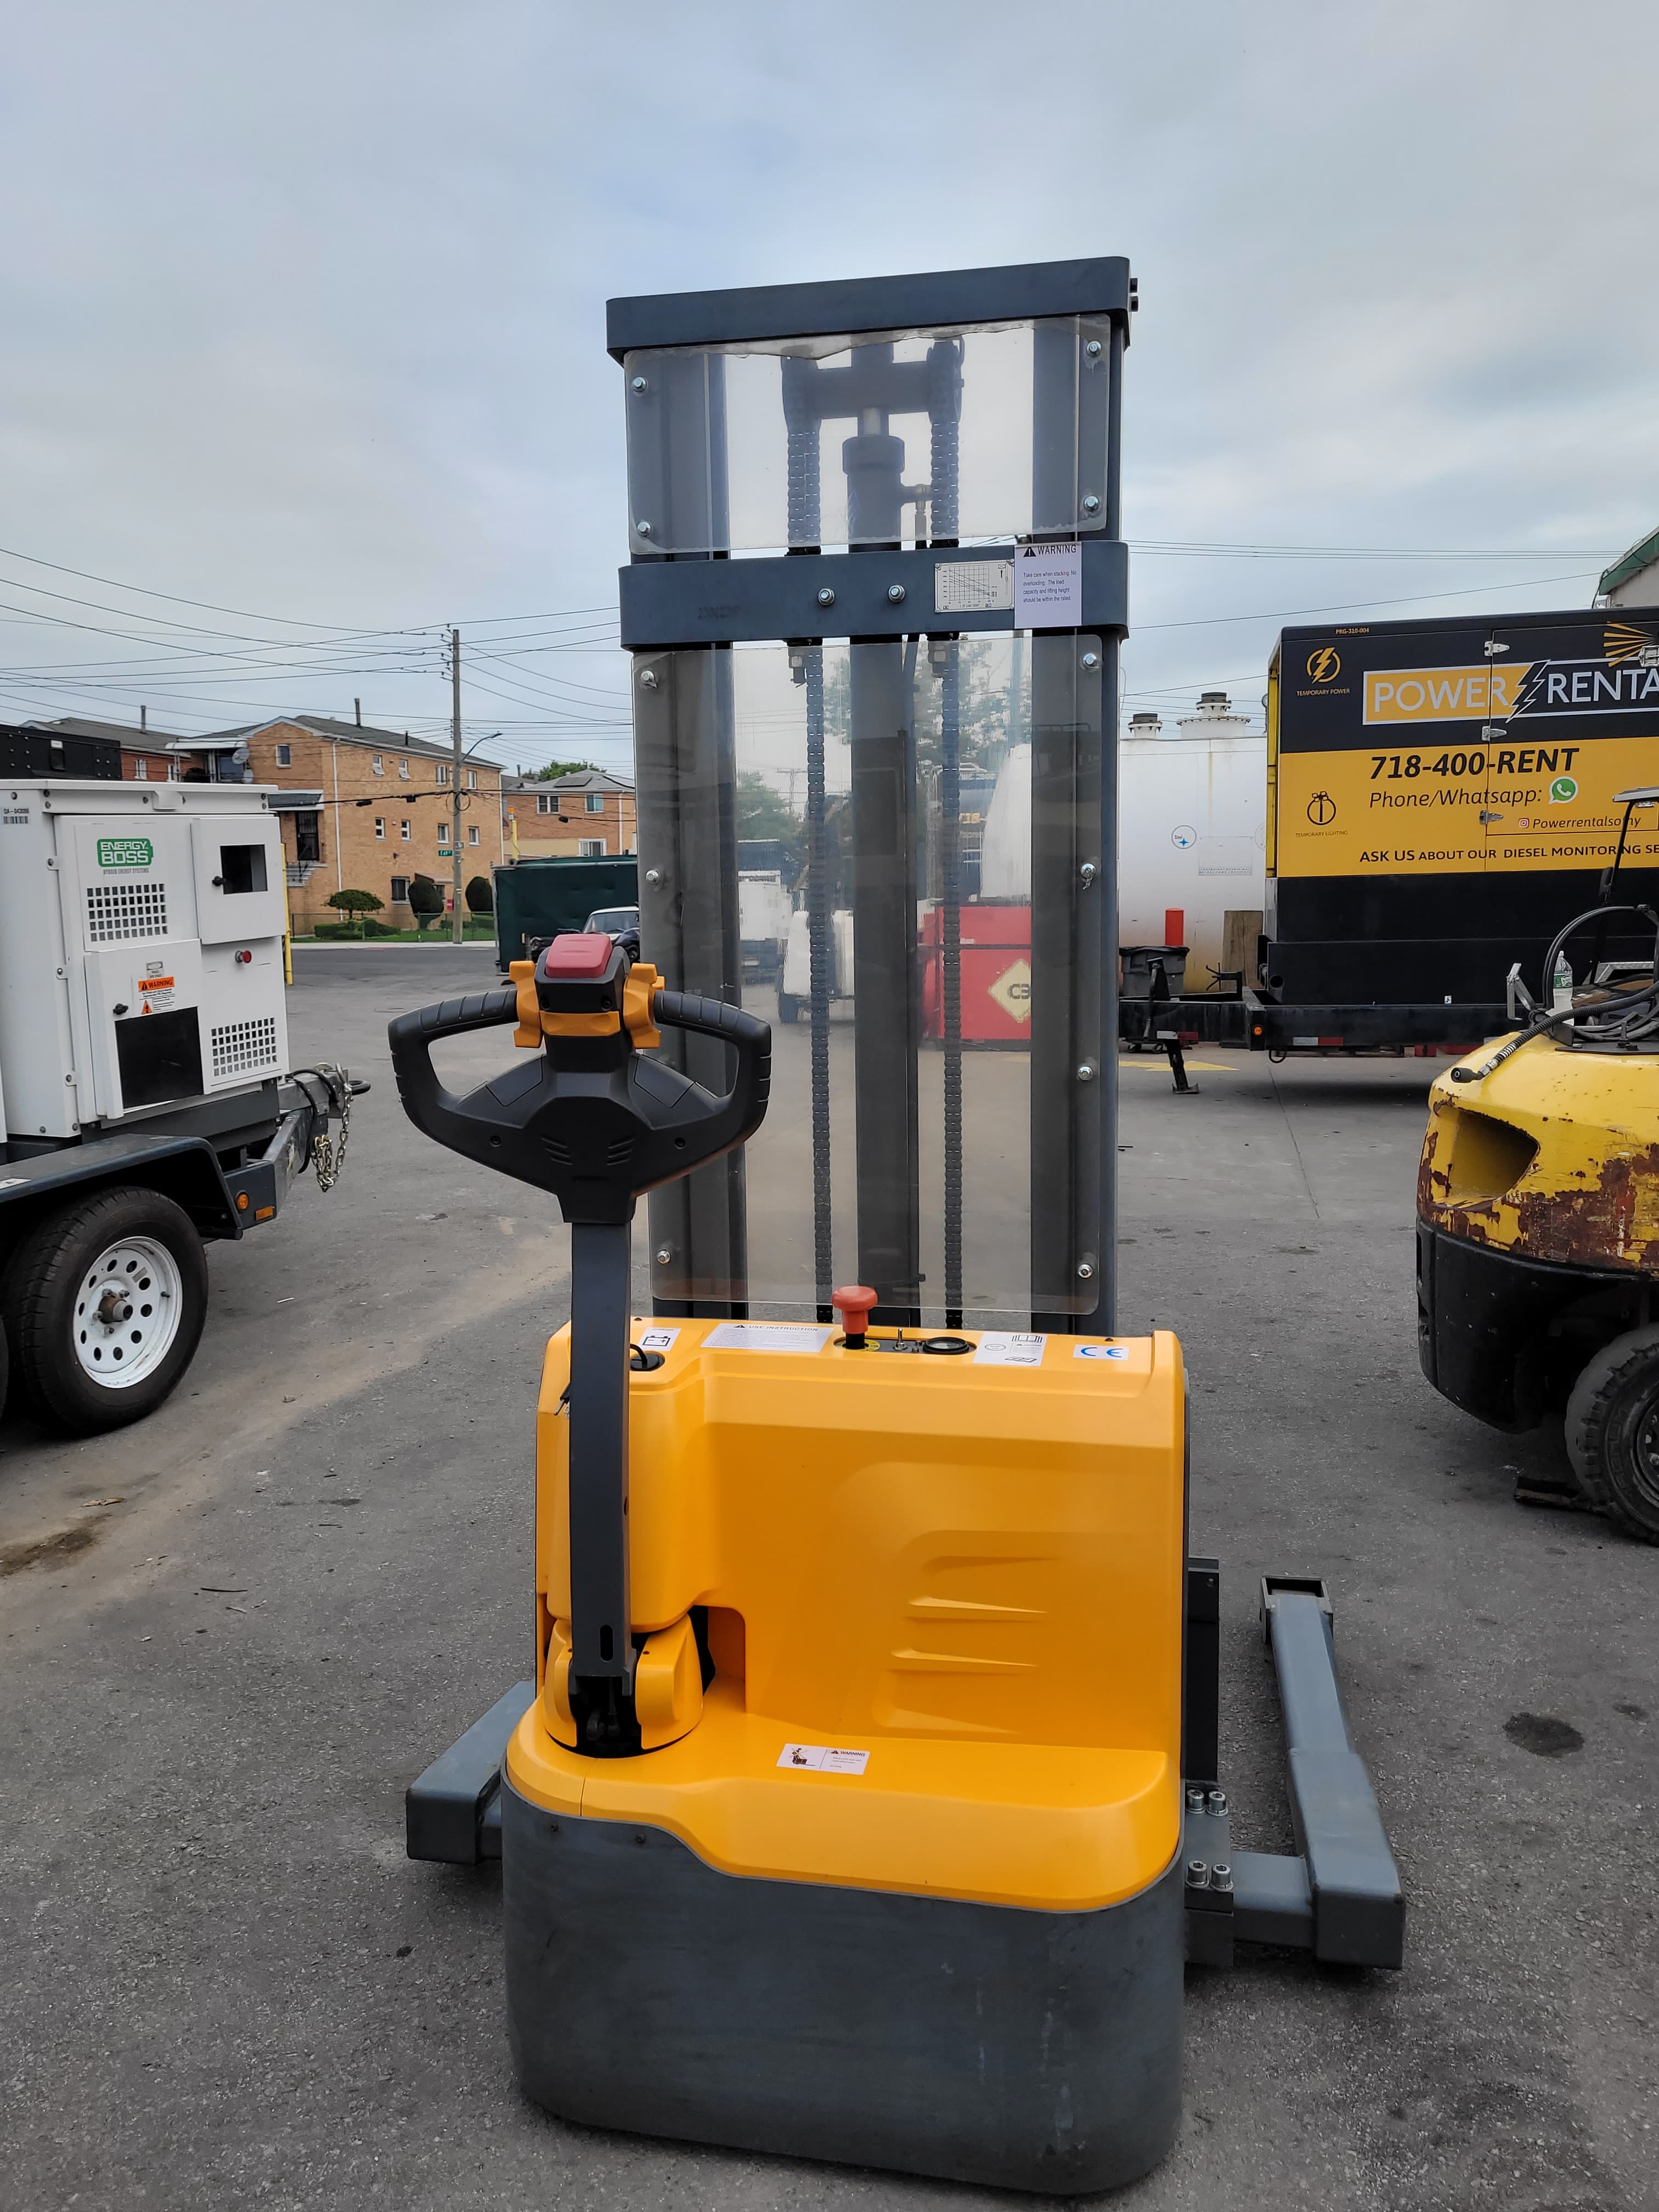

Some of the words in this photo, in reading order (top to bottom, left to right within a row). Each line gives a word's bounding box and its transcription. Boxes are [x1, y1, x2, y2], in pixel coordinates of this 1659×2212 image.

[1037, 544, 1077, 555] WARNING
[1374, 676, 1510, 713] POWER
[1547, 667, 1659, 704] RENTA
[1370, 748, 1580, 780] 718-400-RENT
[1369, 788, 1542, 808] Phone/Whatsapp:
[1532, 816, 1641, 829] Powerrentalsony
[100, 840, 148, 851] ENERGY
[101, 850, 149, 865] BOSS
[1359, 851, 1389, 862] ASK
[1394, 850, 1415, 861] US
[1418, 850, 1464, 861] ABOUT
[1468, 849, 1497, 859] OUR
[1504, 848, 1548, 858] DIESEL
[1551, 845, 1641, 856] MONITORNG
[149, 979, 173, 988] WARNING
